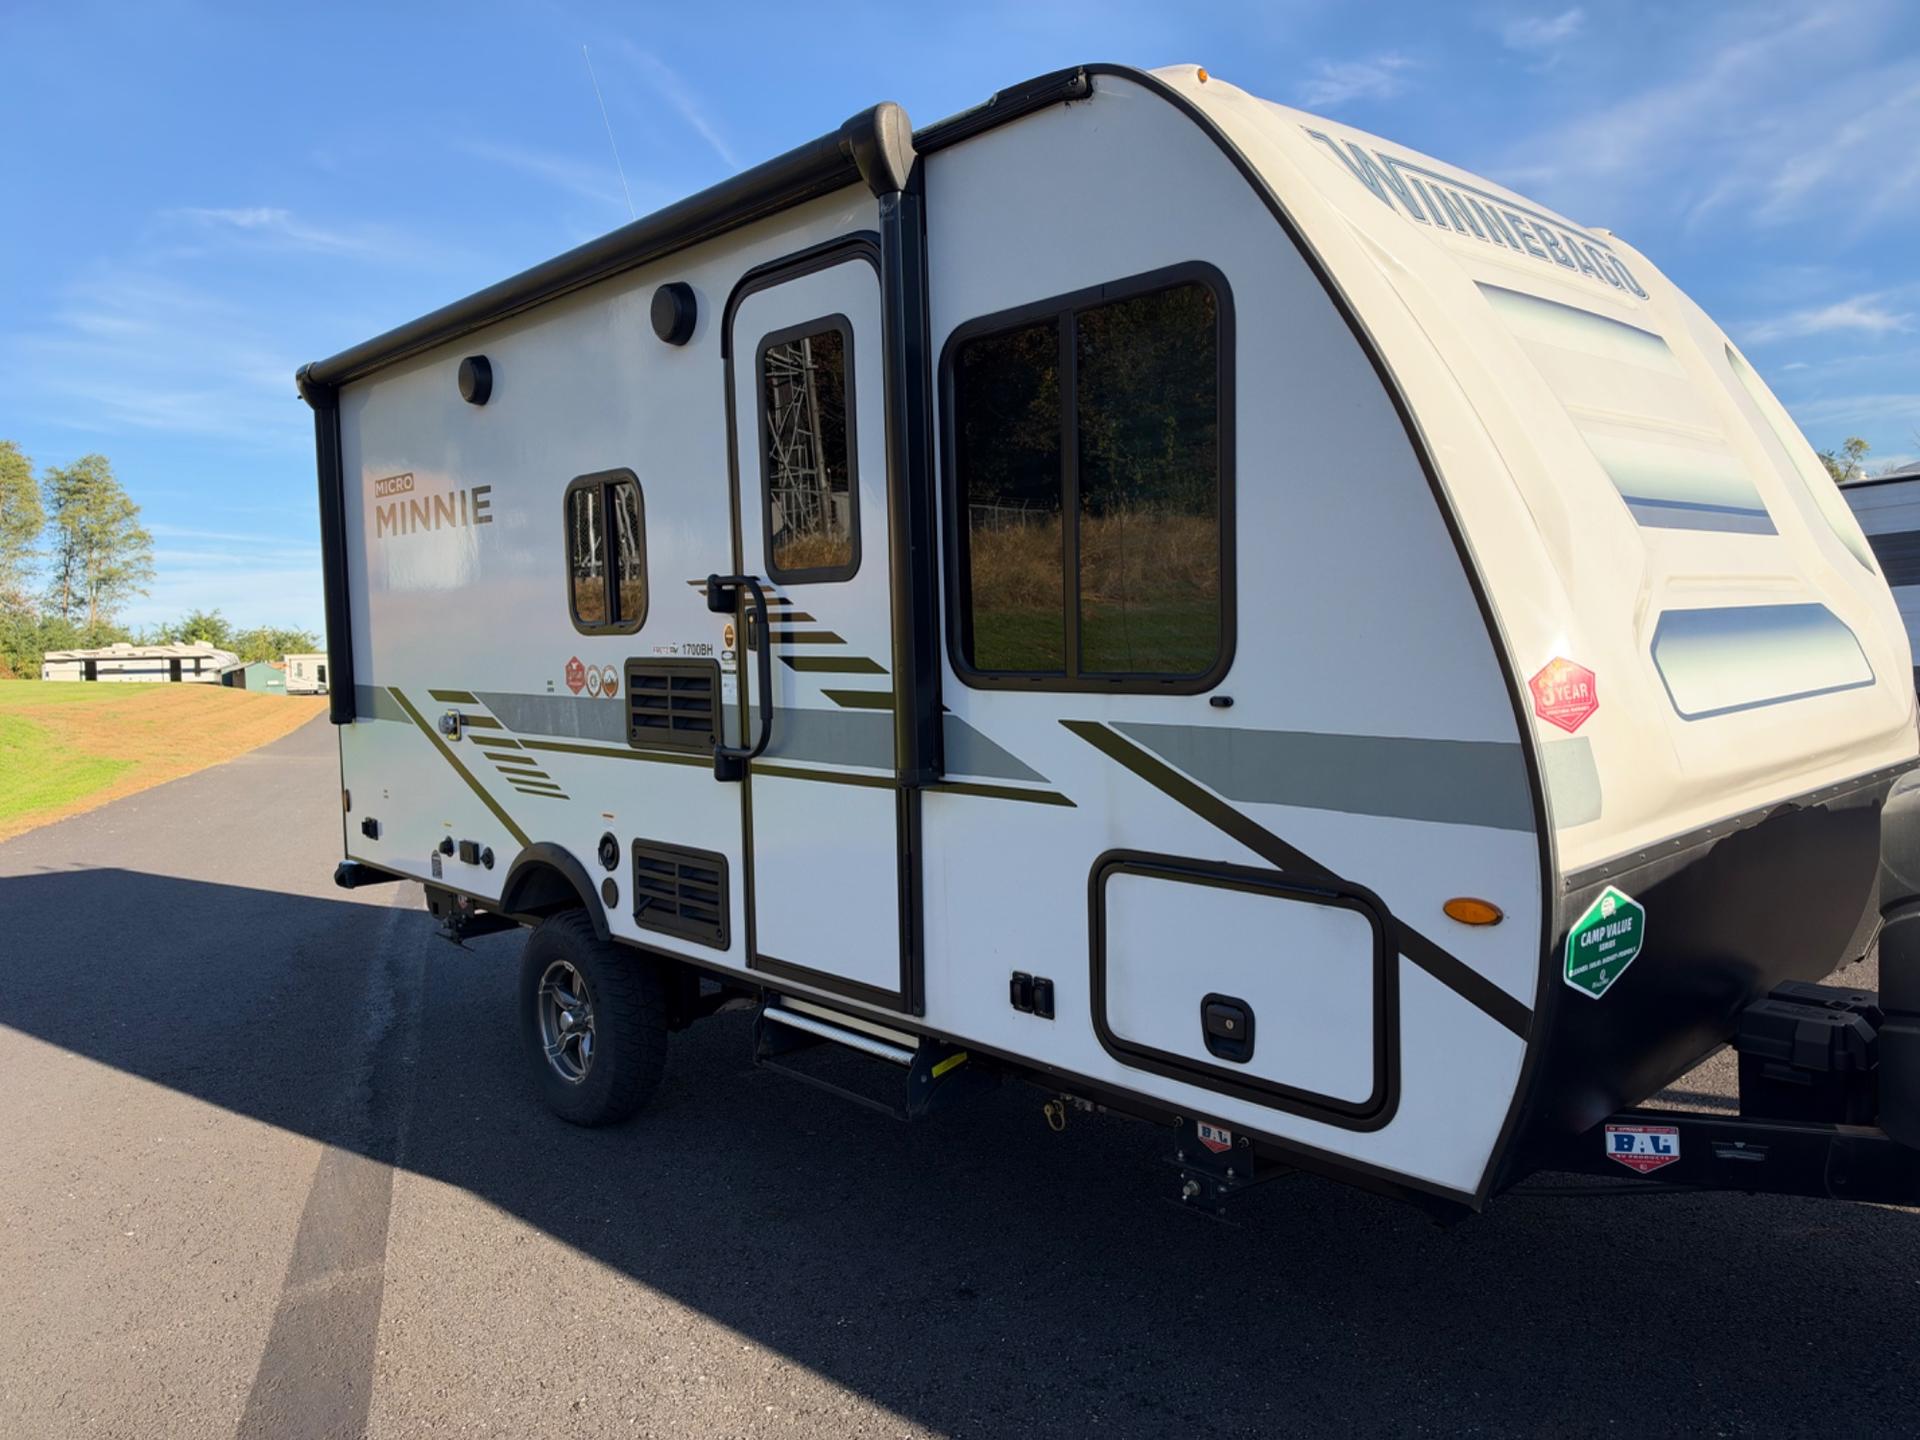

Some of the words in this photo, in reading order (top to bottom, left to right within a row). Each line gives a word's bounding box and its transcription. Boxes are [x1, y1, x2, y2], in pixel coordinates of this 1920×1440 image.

[1299, 125, 1649, 300] WINNEBAGO
[375, 475, 413, 496] MICRO
[376, 485, 493, 538] MINNIE
[682, 643, 713, 656] 1700BH
[1555, 683, 1588, 702] YEAR
[1581, 926, 1606, 947] CAMP
[1606, 917, 1633, 938] VALUE
[1613, 1134, 1671, 1153] BAL
